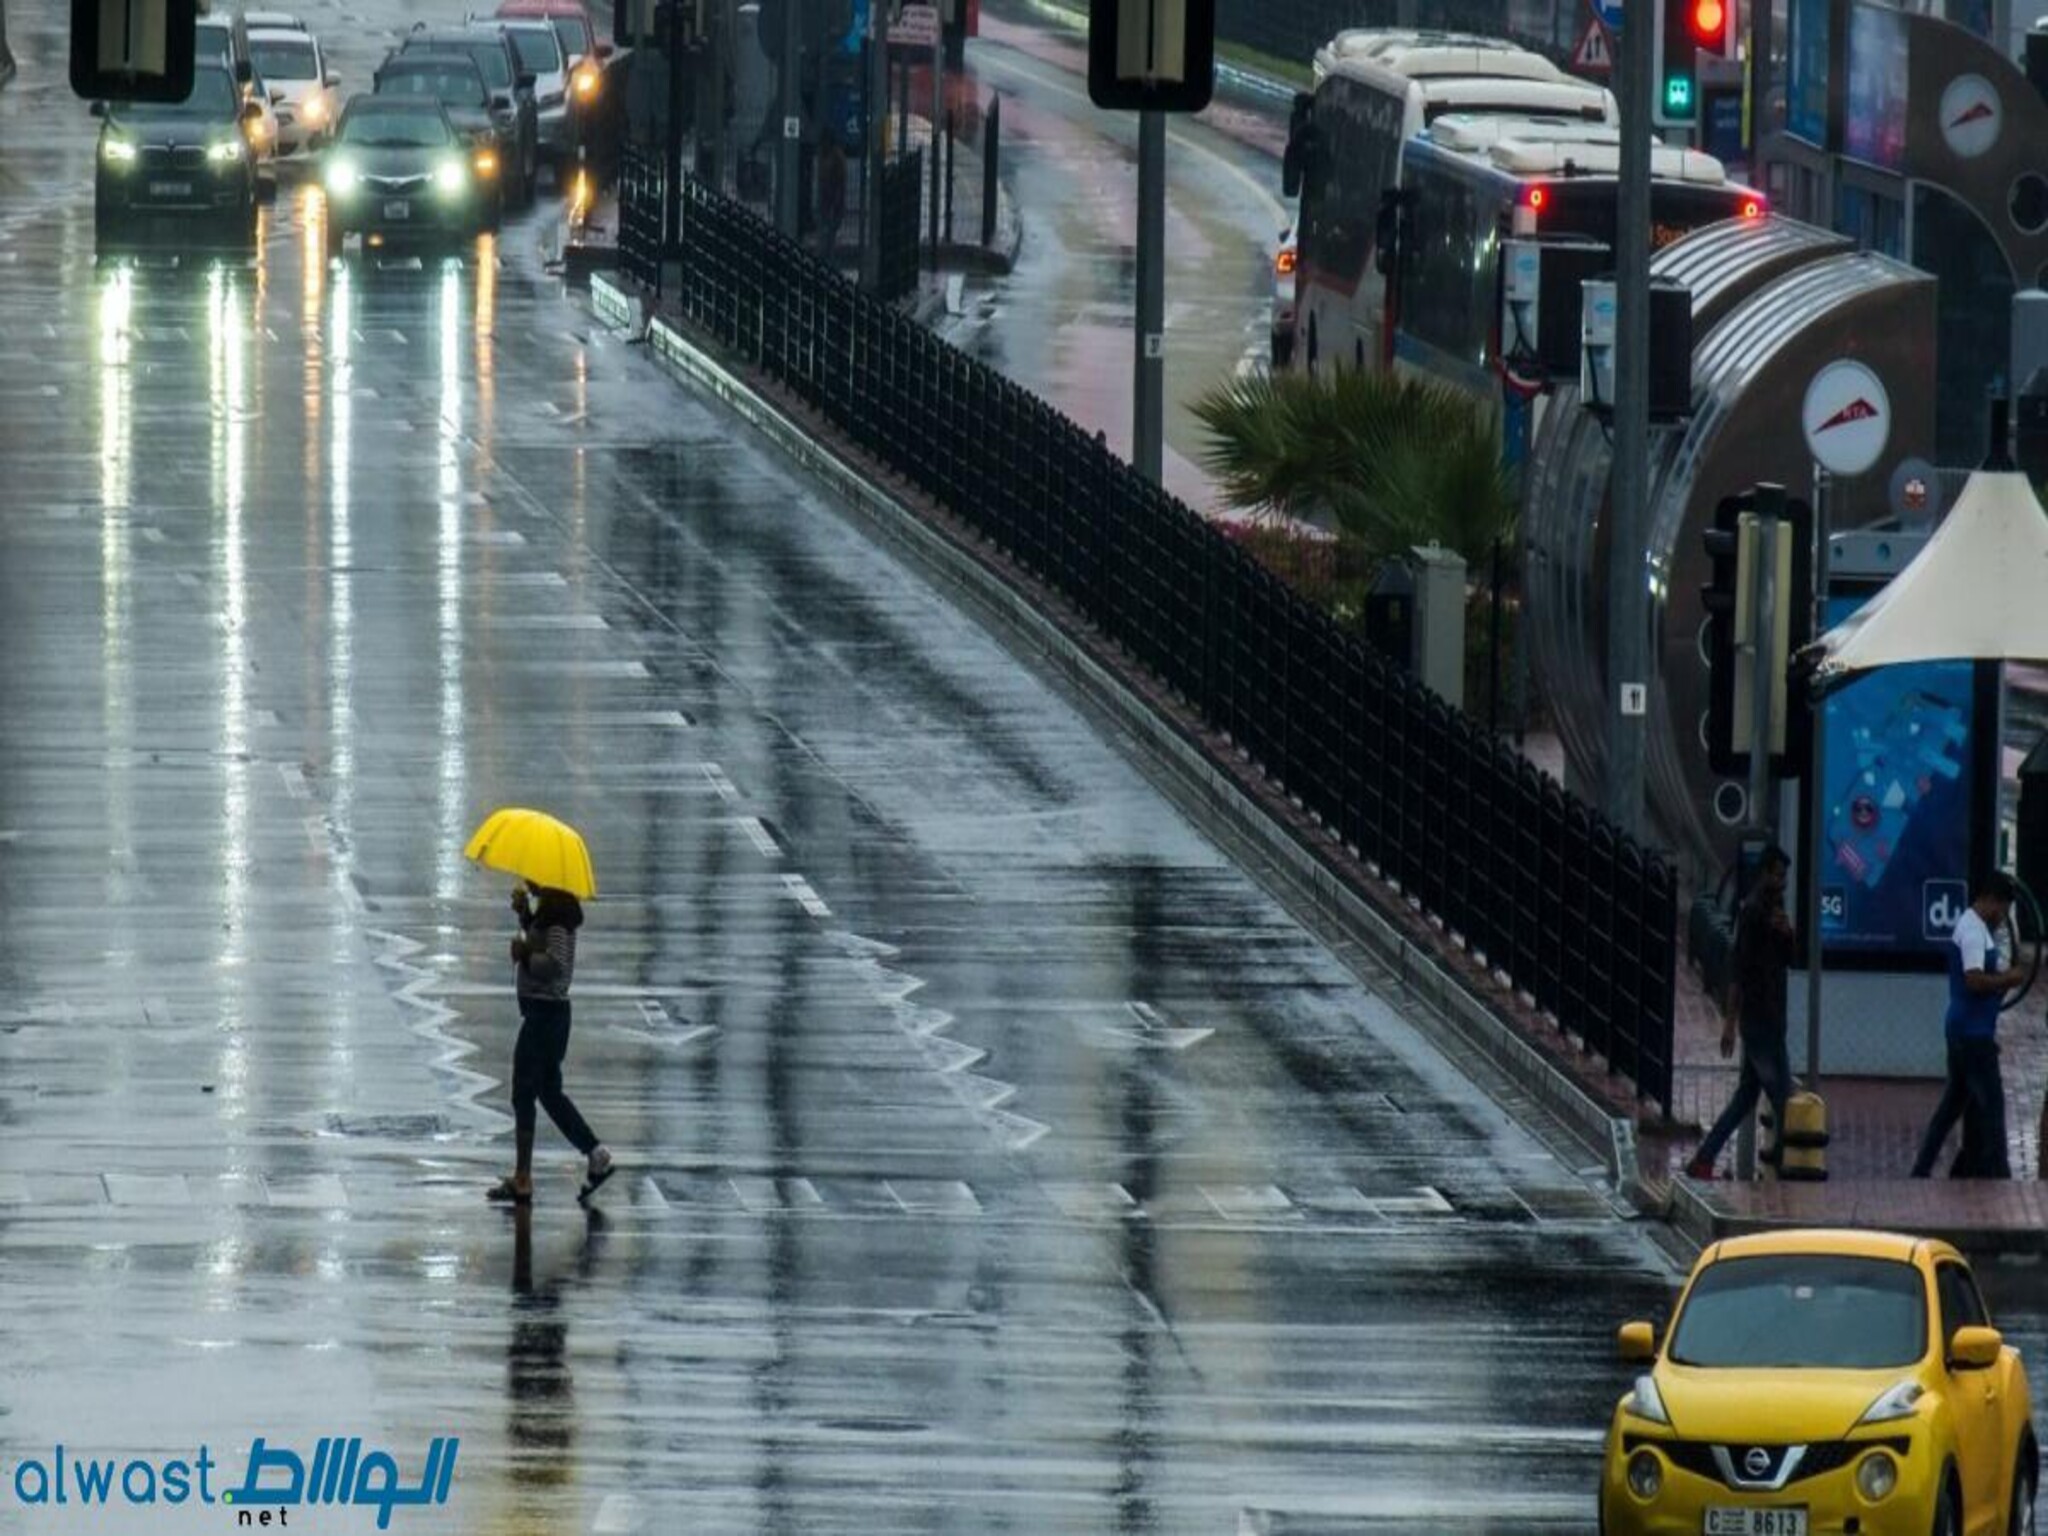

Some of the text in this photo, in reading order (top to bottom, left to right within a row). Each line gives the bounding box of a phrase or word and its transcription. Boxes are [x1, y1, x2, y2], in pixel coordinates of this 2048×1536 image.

[1821, 895, 1842, 915] 5G
[1929, 893, 1961, 928] du
[1709, 1510, 1719, 1532] C
[1753, 1511, 1797, 1536] 8613
